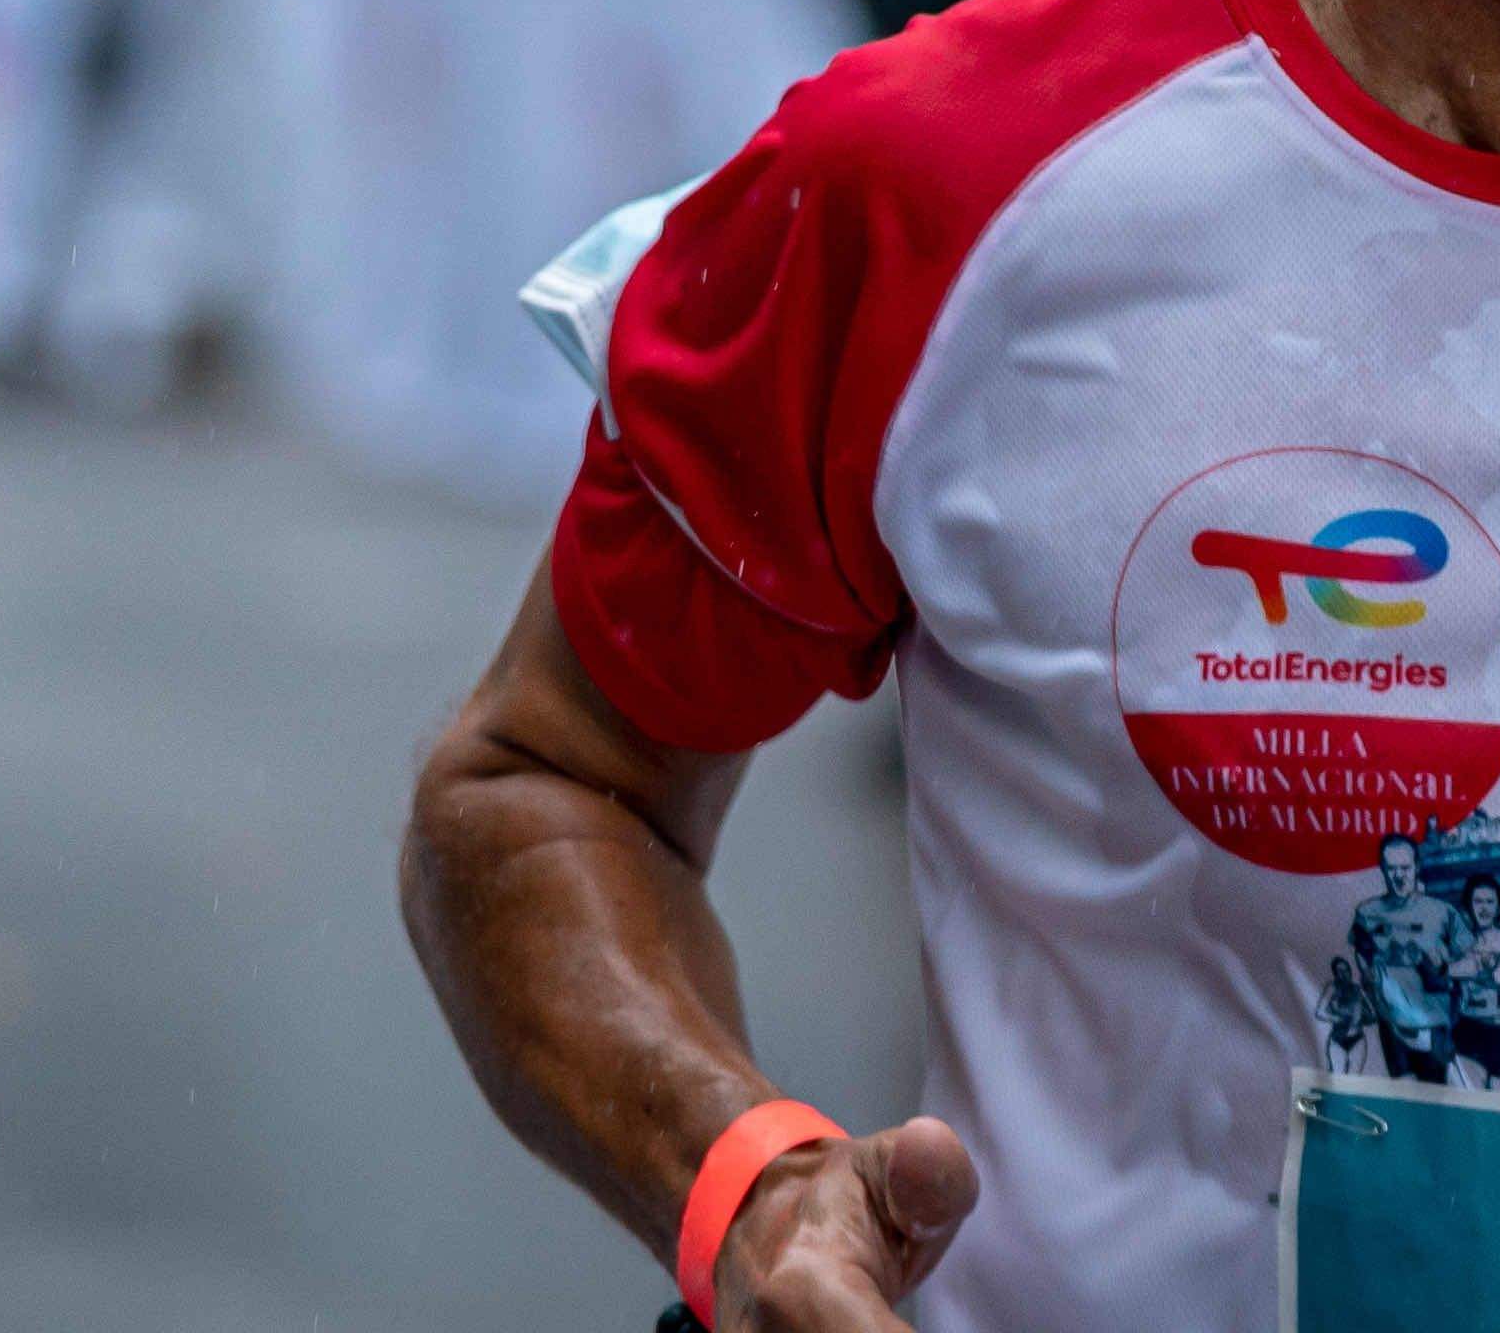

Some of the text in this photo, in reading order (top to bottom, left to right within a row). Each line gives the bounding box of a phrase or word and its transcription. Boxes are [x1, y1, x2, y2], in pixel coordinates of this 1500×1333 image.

[1196, 652, 1447, 691] TotalEnergies
[1253, 728, 1368, 759] MILLA
[1212, 805, 1419, 834] DE MADRID
